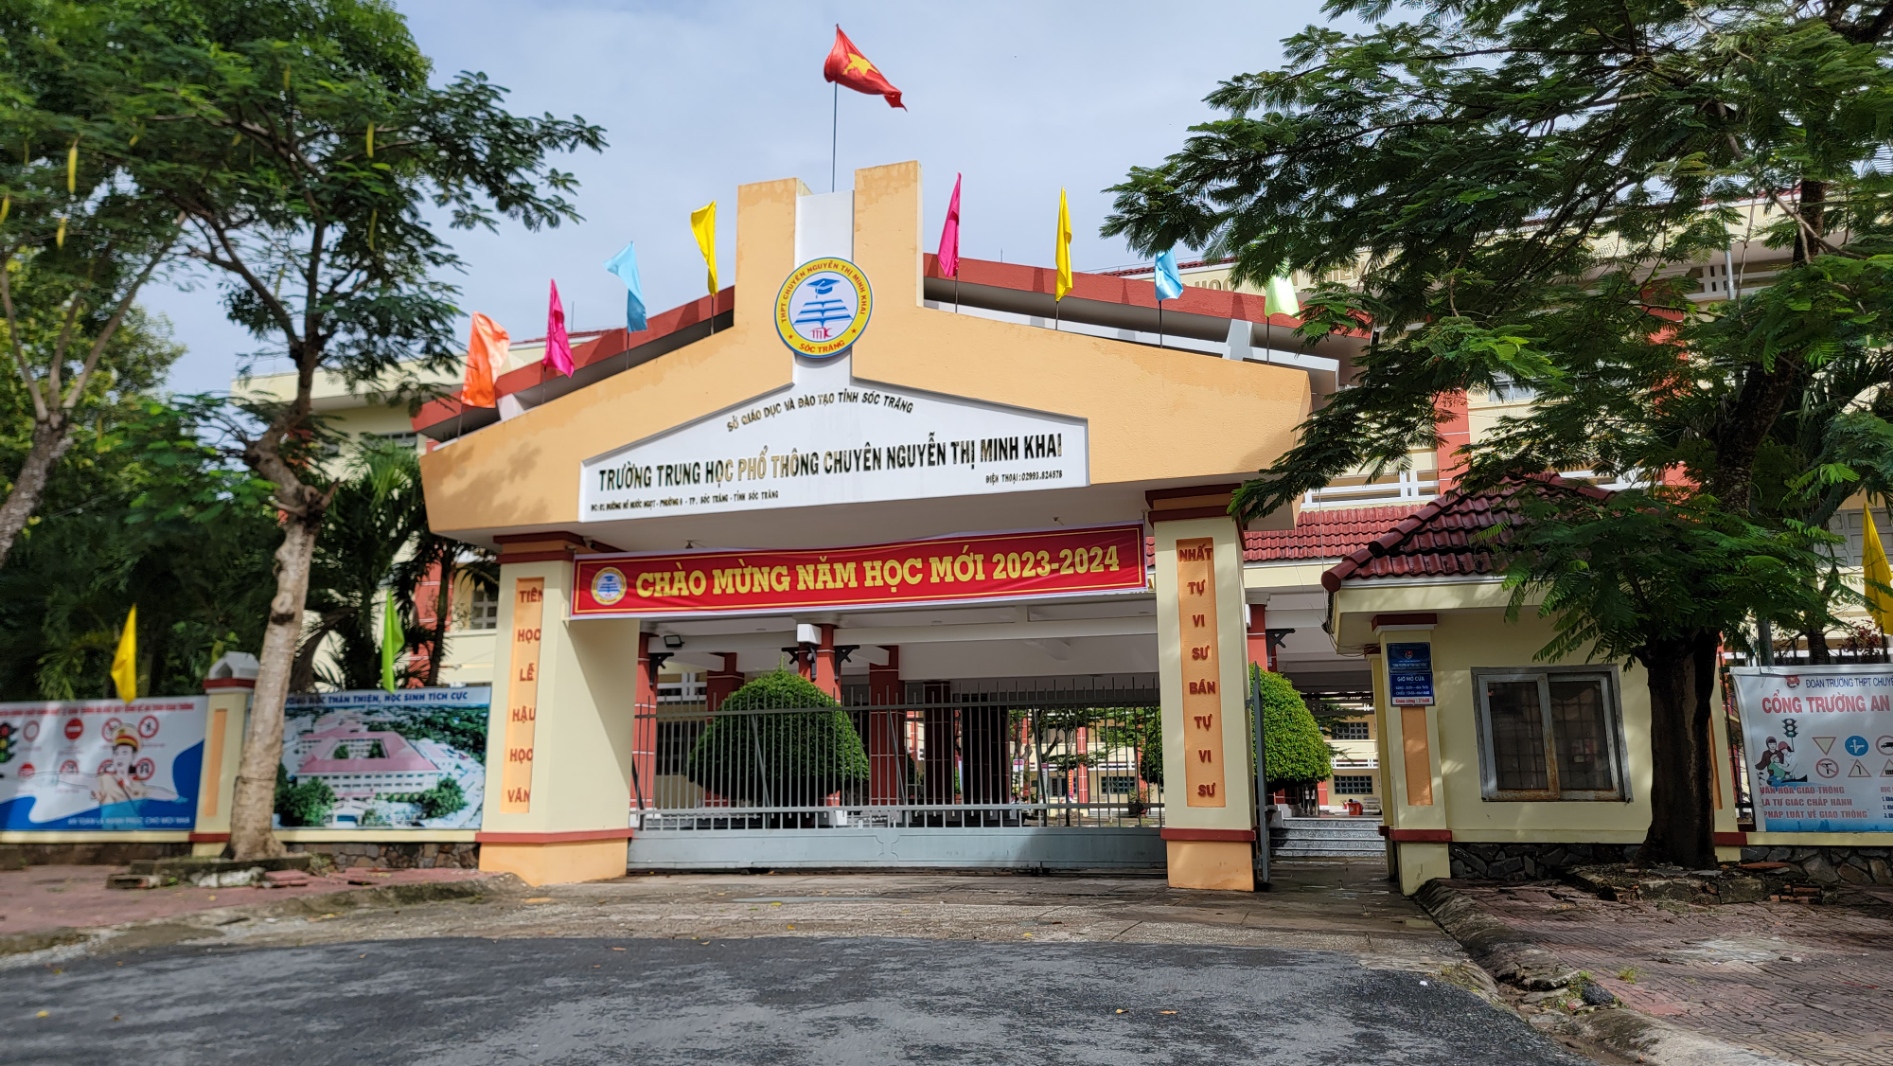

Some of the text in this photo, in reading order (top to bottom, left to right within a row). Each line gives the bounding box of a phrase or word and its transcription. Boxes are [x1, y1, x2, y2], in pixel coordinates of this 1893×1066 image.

[852, 274, 866, 293] MINH
[859, 294, 867, 315] KHAI
[726, 388, 914, 432] SỞ GIÁO DỤC VÀ ĐÀO TẠO TỈNH SÓC TRĂNG
[599, 431, 1062, 492] TRƯỜNG TRUNG HỌC PHỔ THÔNG CHUYÊN NGUYỄN THỊ MINH KHAI
[636, 561, 706, 598] CHÀO
[713, 557, 790, 595] MỪNG
[796, 556, 857, 592] NĂM
[864, 558, 924, 593] HỌC
[929, 545, 986, 583] MỚI
[992, 545, 1121, 580] 2023-2024
[1179, 543, 1216, 798] NHẤT TỰ VI SƯ BÁN TỰ VI SƯ
[1826, 677, 1854, 688] TRƯỜNG
[1855, 677, 1871, 687] THPT
[384, 693, 401, 703] HỌC
[404, 693, 425, 701] SINH
[428, 691, 448, 701] TÍCH
[451, 691, 468, 701] CỰC
[507, 586, 544, 803] TIÊN HỌC LỄ HẬU HỌC VĂN
[1762, 689, 1890, 714] CỔNG TRƯỜNG AN
[1796, 786, 1815, 794] GIAO
[1818, 785, 1845, 794] THÔNG
[1819, 810, 1838, 818] GIAO
